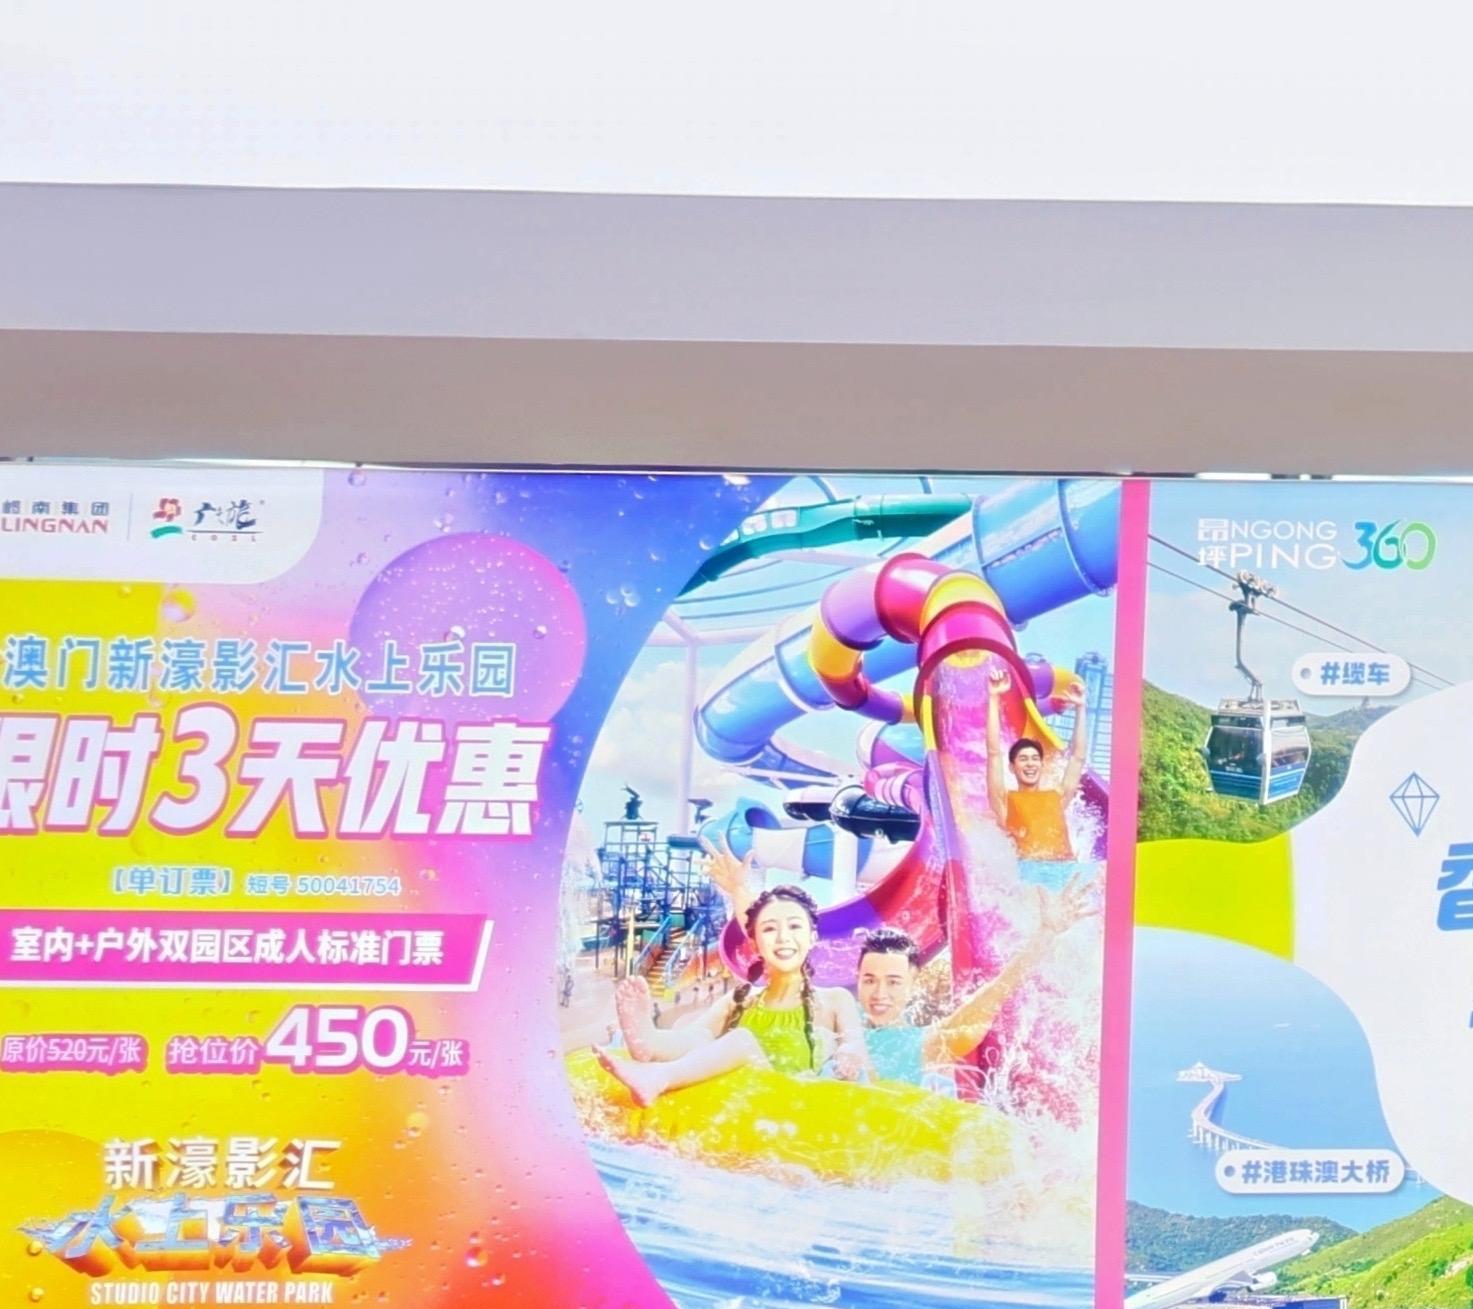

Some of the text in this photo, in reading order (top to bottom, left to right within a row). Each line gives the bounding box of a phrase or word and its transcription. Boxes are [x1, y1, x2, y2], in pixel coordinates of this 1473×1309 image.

[1, 518, 108, 533] LINGNAN
[1230, 522, 1337, 542] NGONG
[1230, 544, 1336, 567] PING
[1340, 520, 1436, 571] 360
[4, 639, 515, 696] 澳门新濠影汇水上乐园
[1320, 660, 1390, 687] #缆车
[108, 865, 401, 897] 【单订票】 50041754
[11, 928, 443, 968] 室内+户外双园区成人标准门票
[103, 1137, 341, 1190] 新濠影汇
[1242, 1158, 1390, 1185] #港珠澳大桥
[91, 1281, 333, 1304] STUDIO CITY WATER PARK
